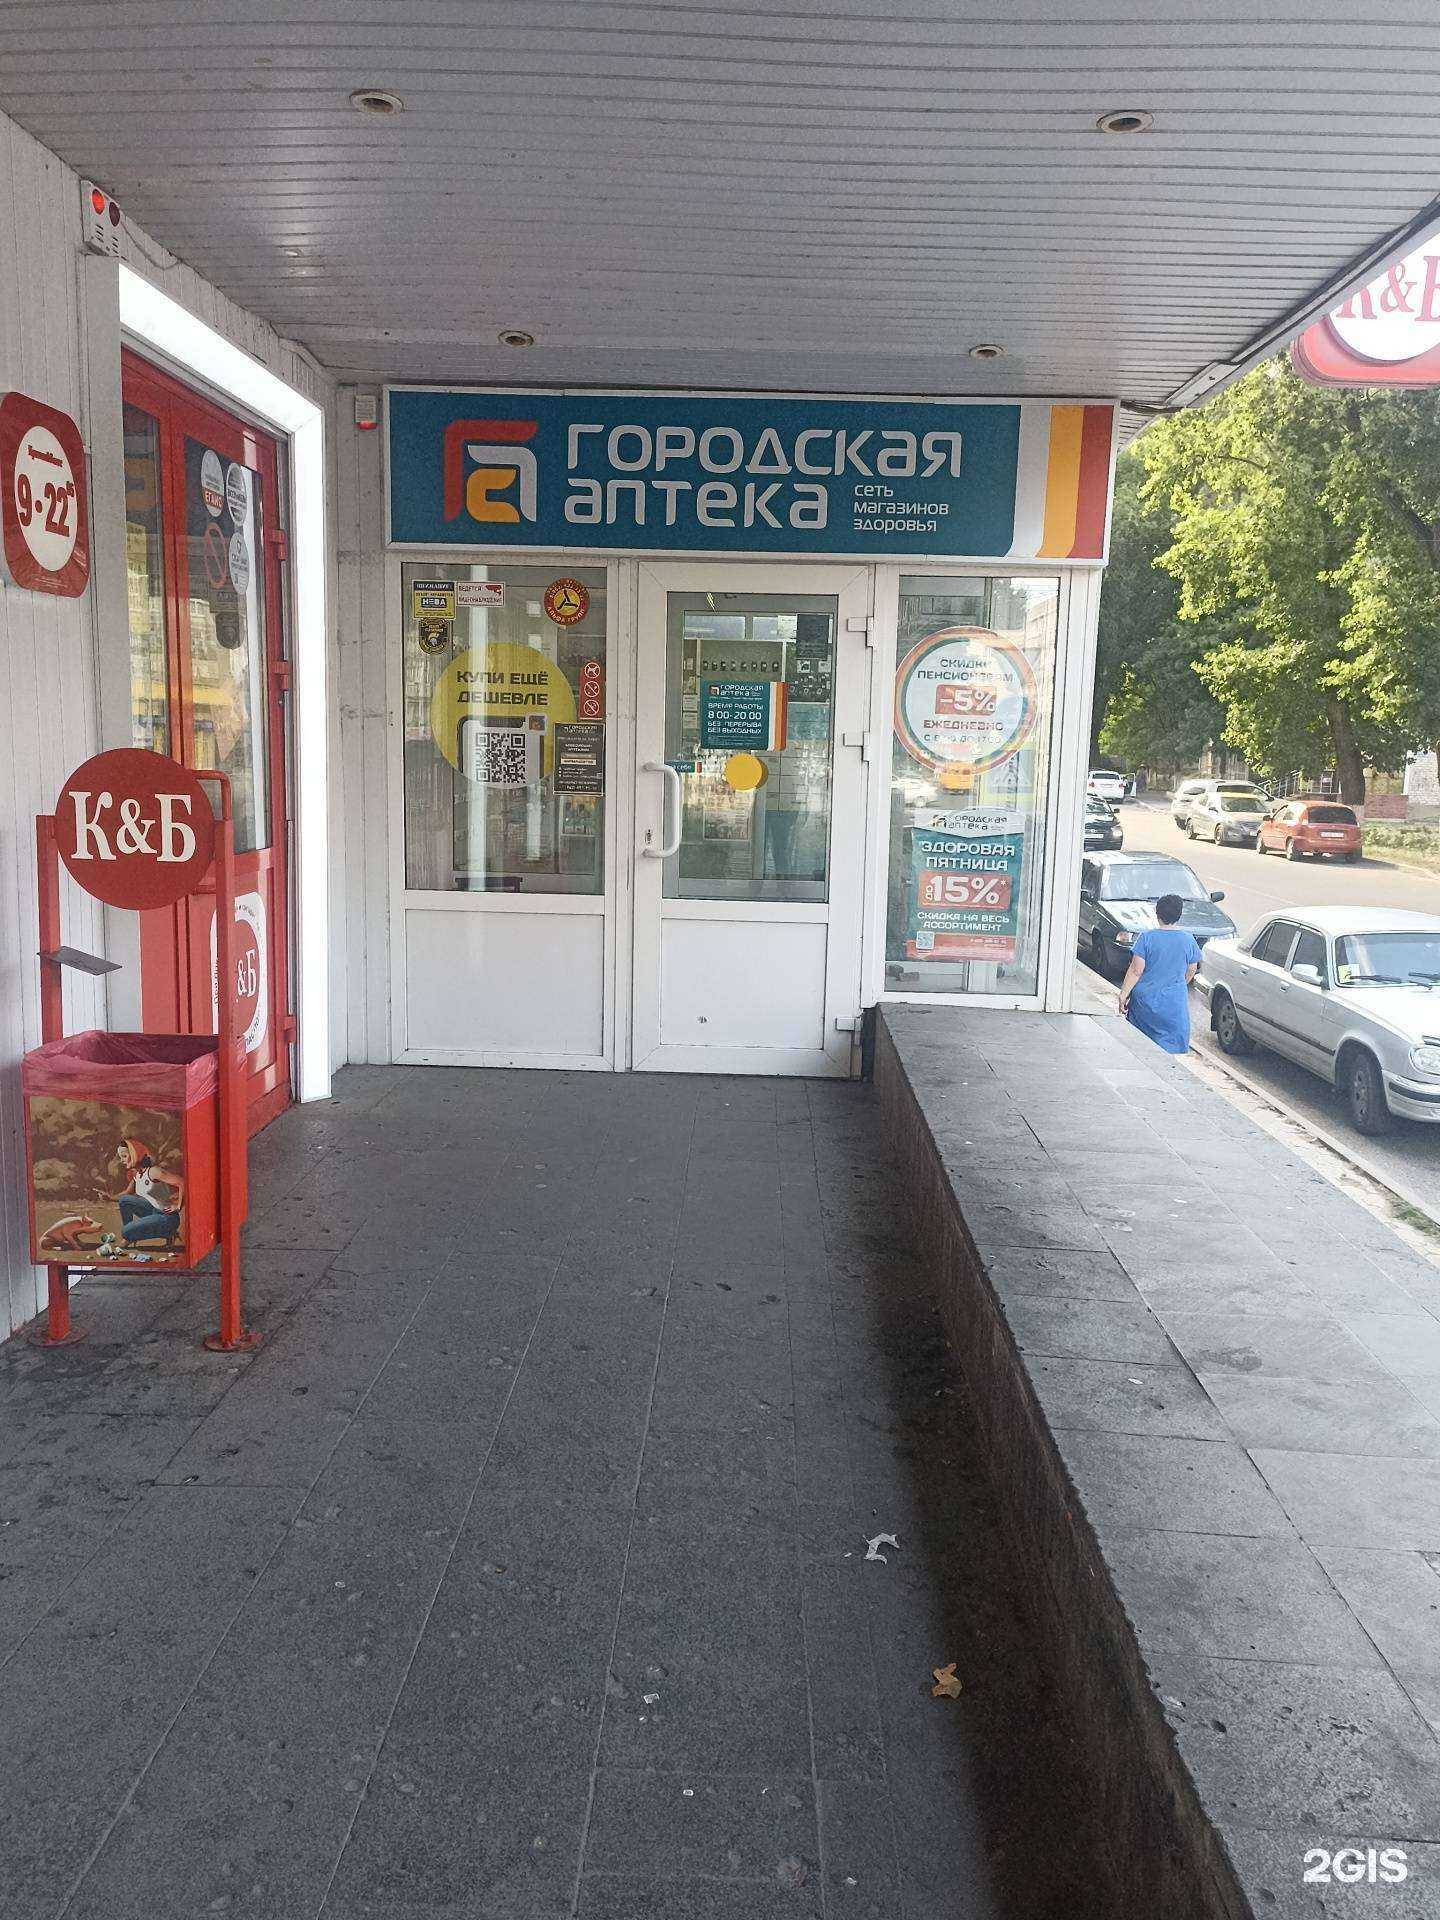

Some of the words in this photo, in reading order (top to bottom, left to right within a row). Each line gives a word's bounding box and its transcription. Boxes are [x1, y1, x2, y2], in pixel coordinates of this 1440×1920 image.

[854, 484, 894, 498] сеть
[853, 502, 949, 515] магазинов
[853, 518, 937, 534] здоровья
[457, 671, 504, 684] КУПИ
[510, 671, 549, 686] ЕЩЁ
[457, 691, 549, 706] ДЕШЕВЛЕ
[734, 703, 764, 711] РАБОТЫ
[69, 791, 196, 862] К&Б
[921, 840, 1015, 857] ЗДОРОВАЯ
[926, 856, 1008, 872] ПЯТНИЦА
[917, 911, 961, 921] СКИДКА
[963, 914, 979, 922] НА
[981, 914, 1010, 924] ВЕСЬ
[923, 921, 1002, 932] АССОРТИМЕНТ
